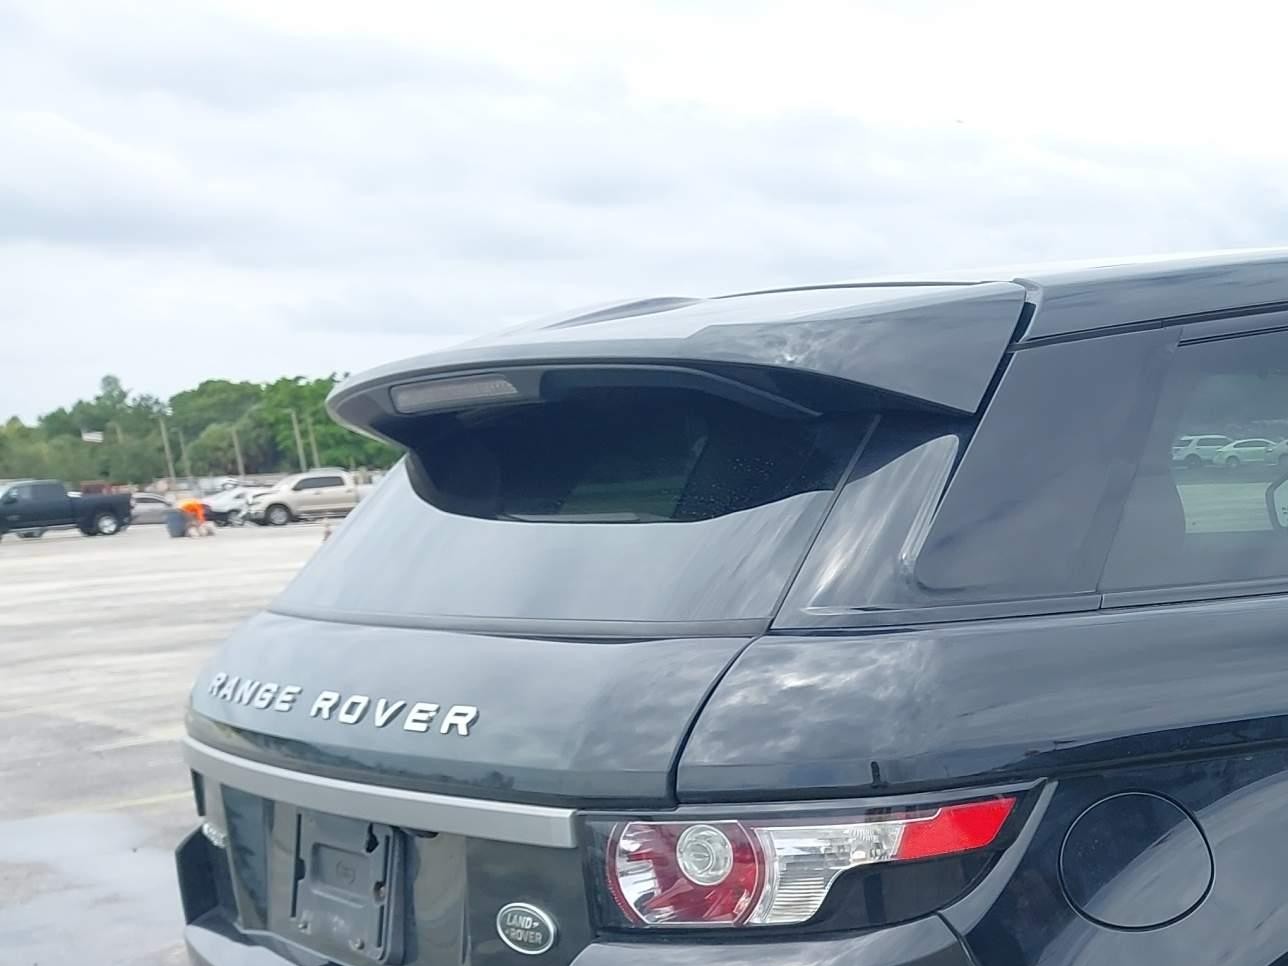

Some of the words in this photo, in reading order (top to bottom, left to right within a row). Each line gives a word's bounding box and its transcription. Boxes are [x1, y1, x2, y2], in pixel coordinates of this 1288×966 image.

[208, 671, 302, 713] RANGE
[309, 691, 479, 737] ROVER
[506, 912, 533, 929] LAND
[508, 928, 543, 944] ROVER
